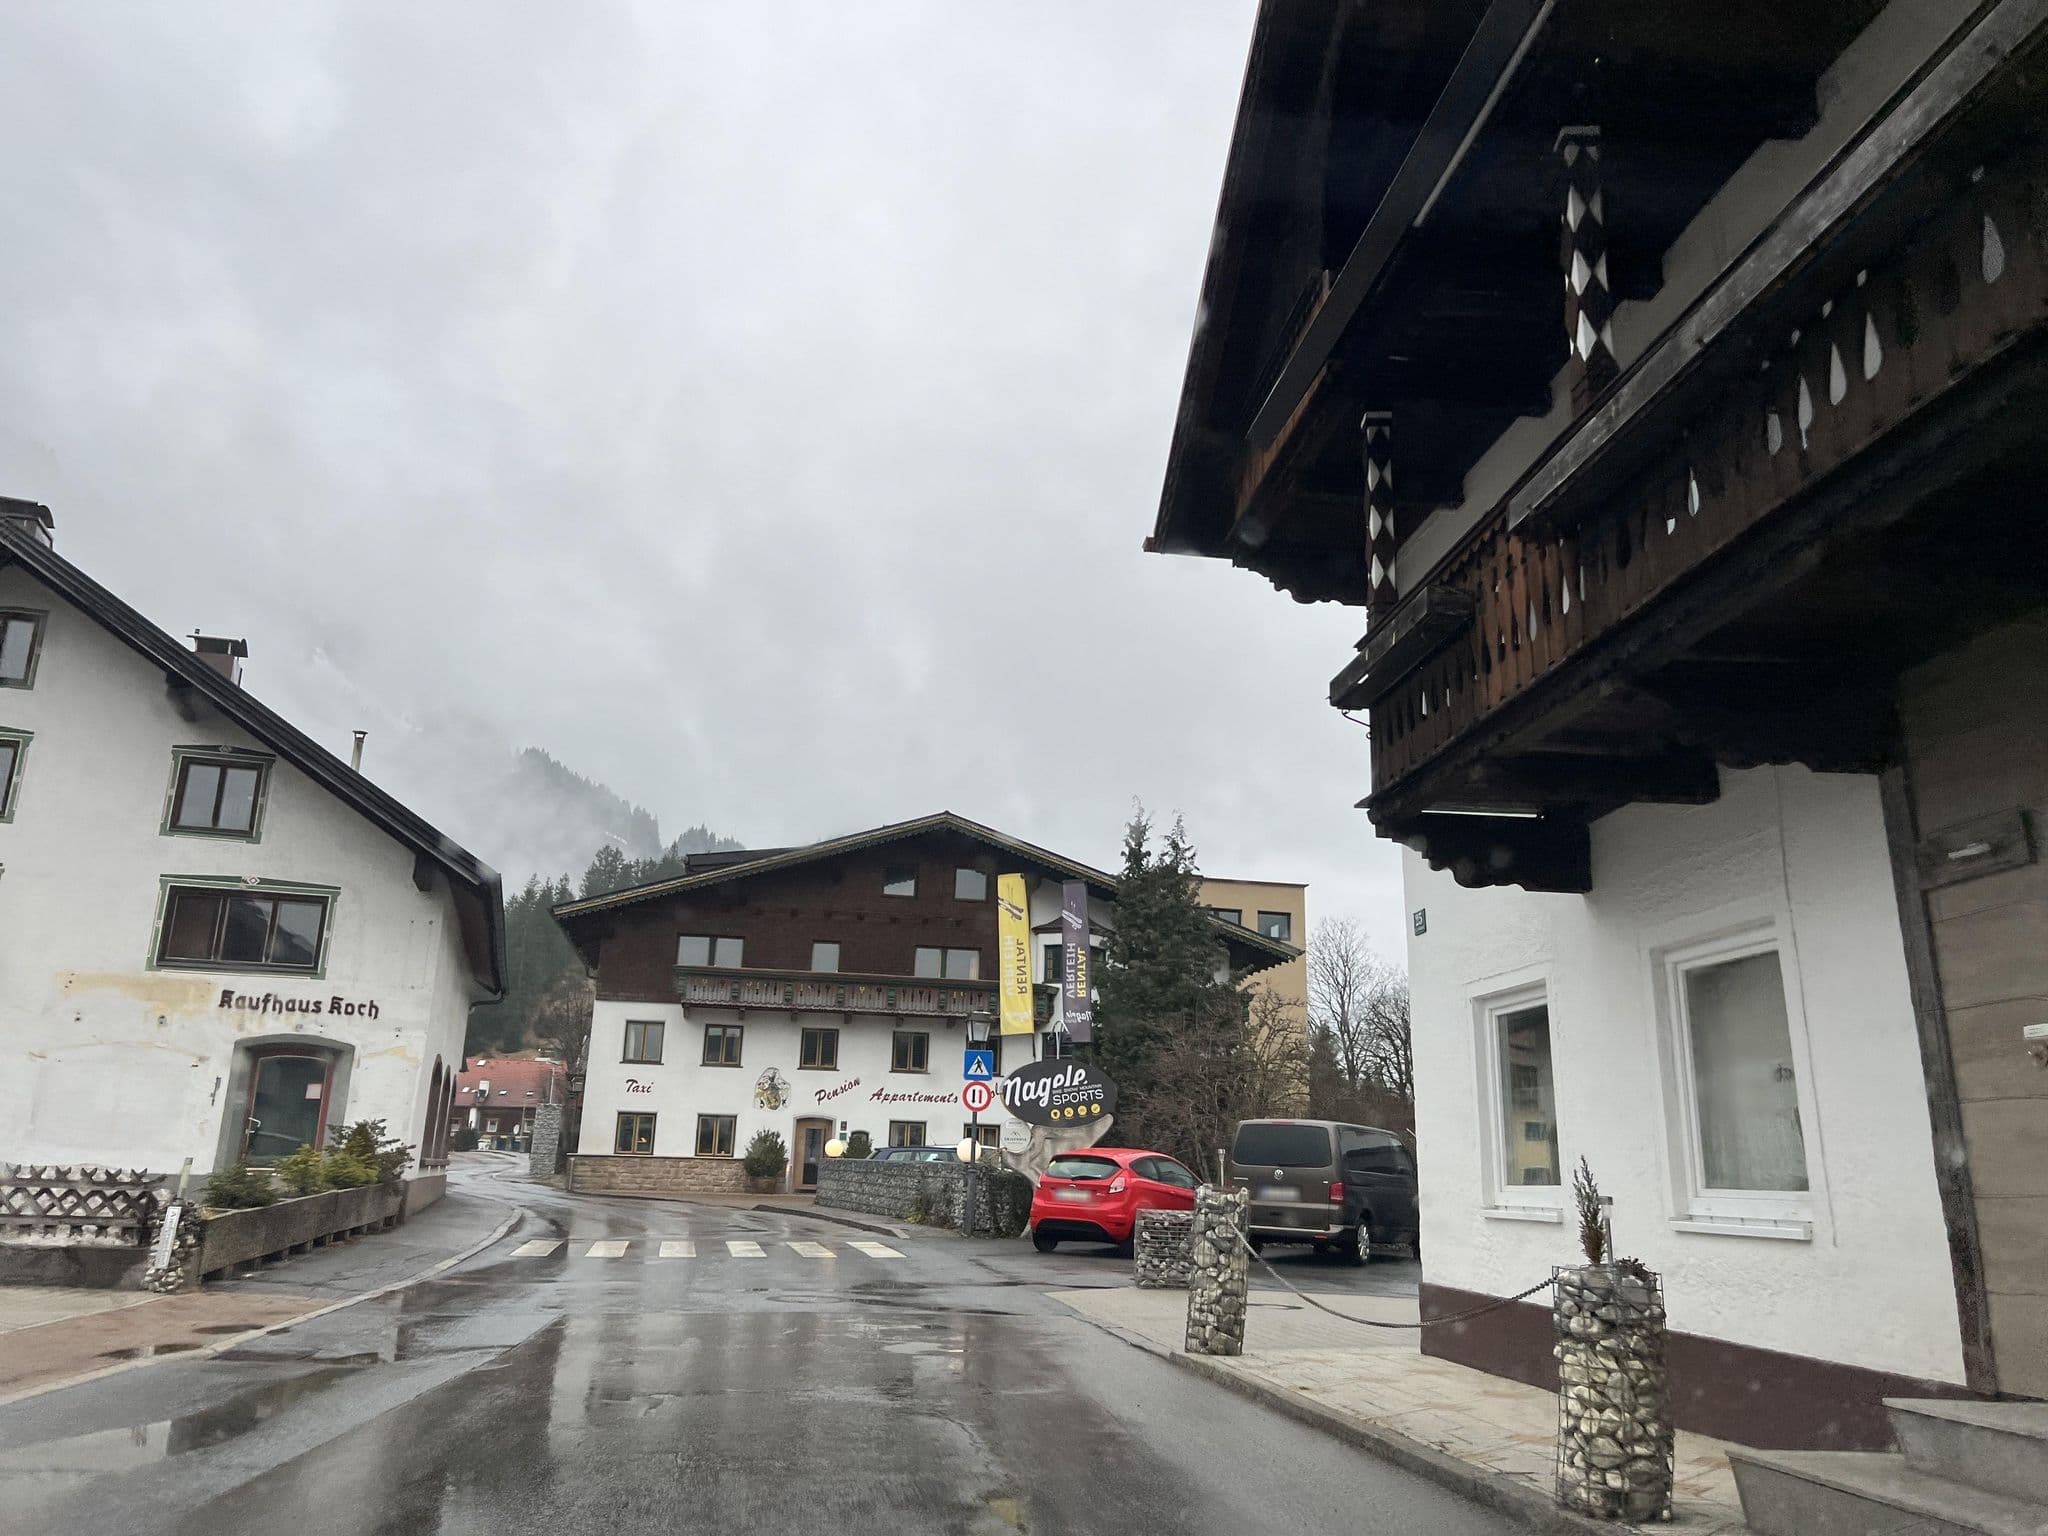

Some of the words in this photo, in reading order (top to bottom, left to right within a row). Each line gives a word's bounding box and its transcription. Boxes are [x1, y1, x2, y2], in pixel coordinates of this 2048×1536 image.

[218, 989, 323, 1015] Kaufhaus
[328, 996, 380, 1020] Koch
[625, 1078, 655, 1094] Taxi
[814, 1077, 862, 1106] Pension
[869, 1086, 959, 1104] Appartements
[1052, 1088, 1104, 1106] SPORTS
